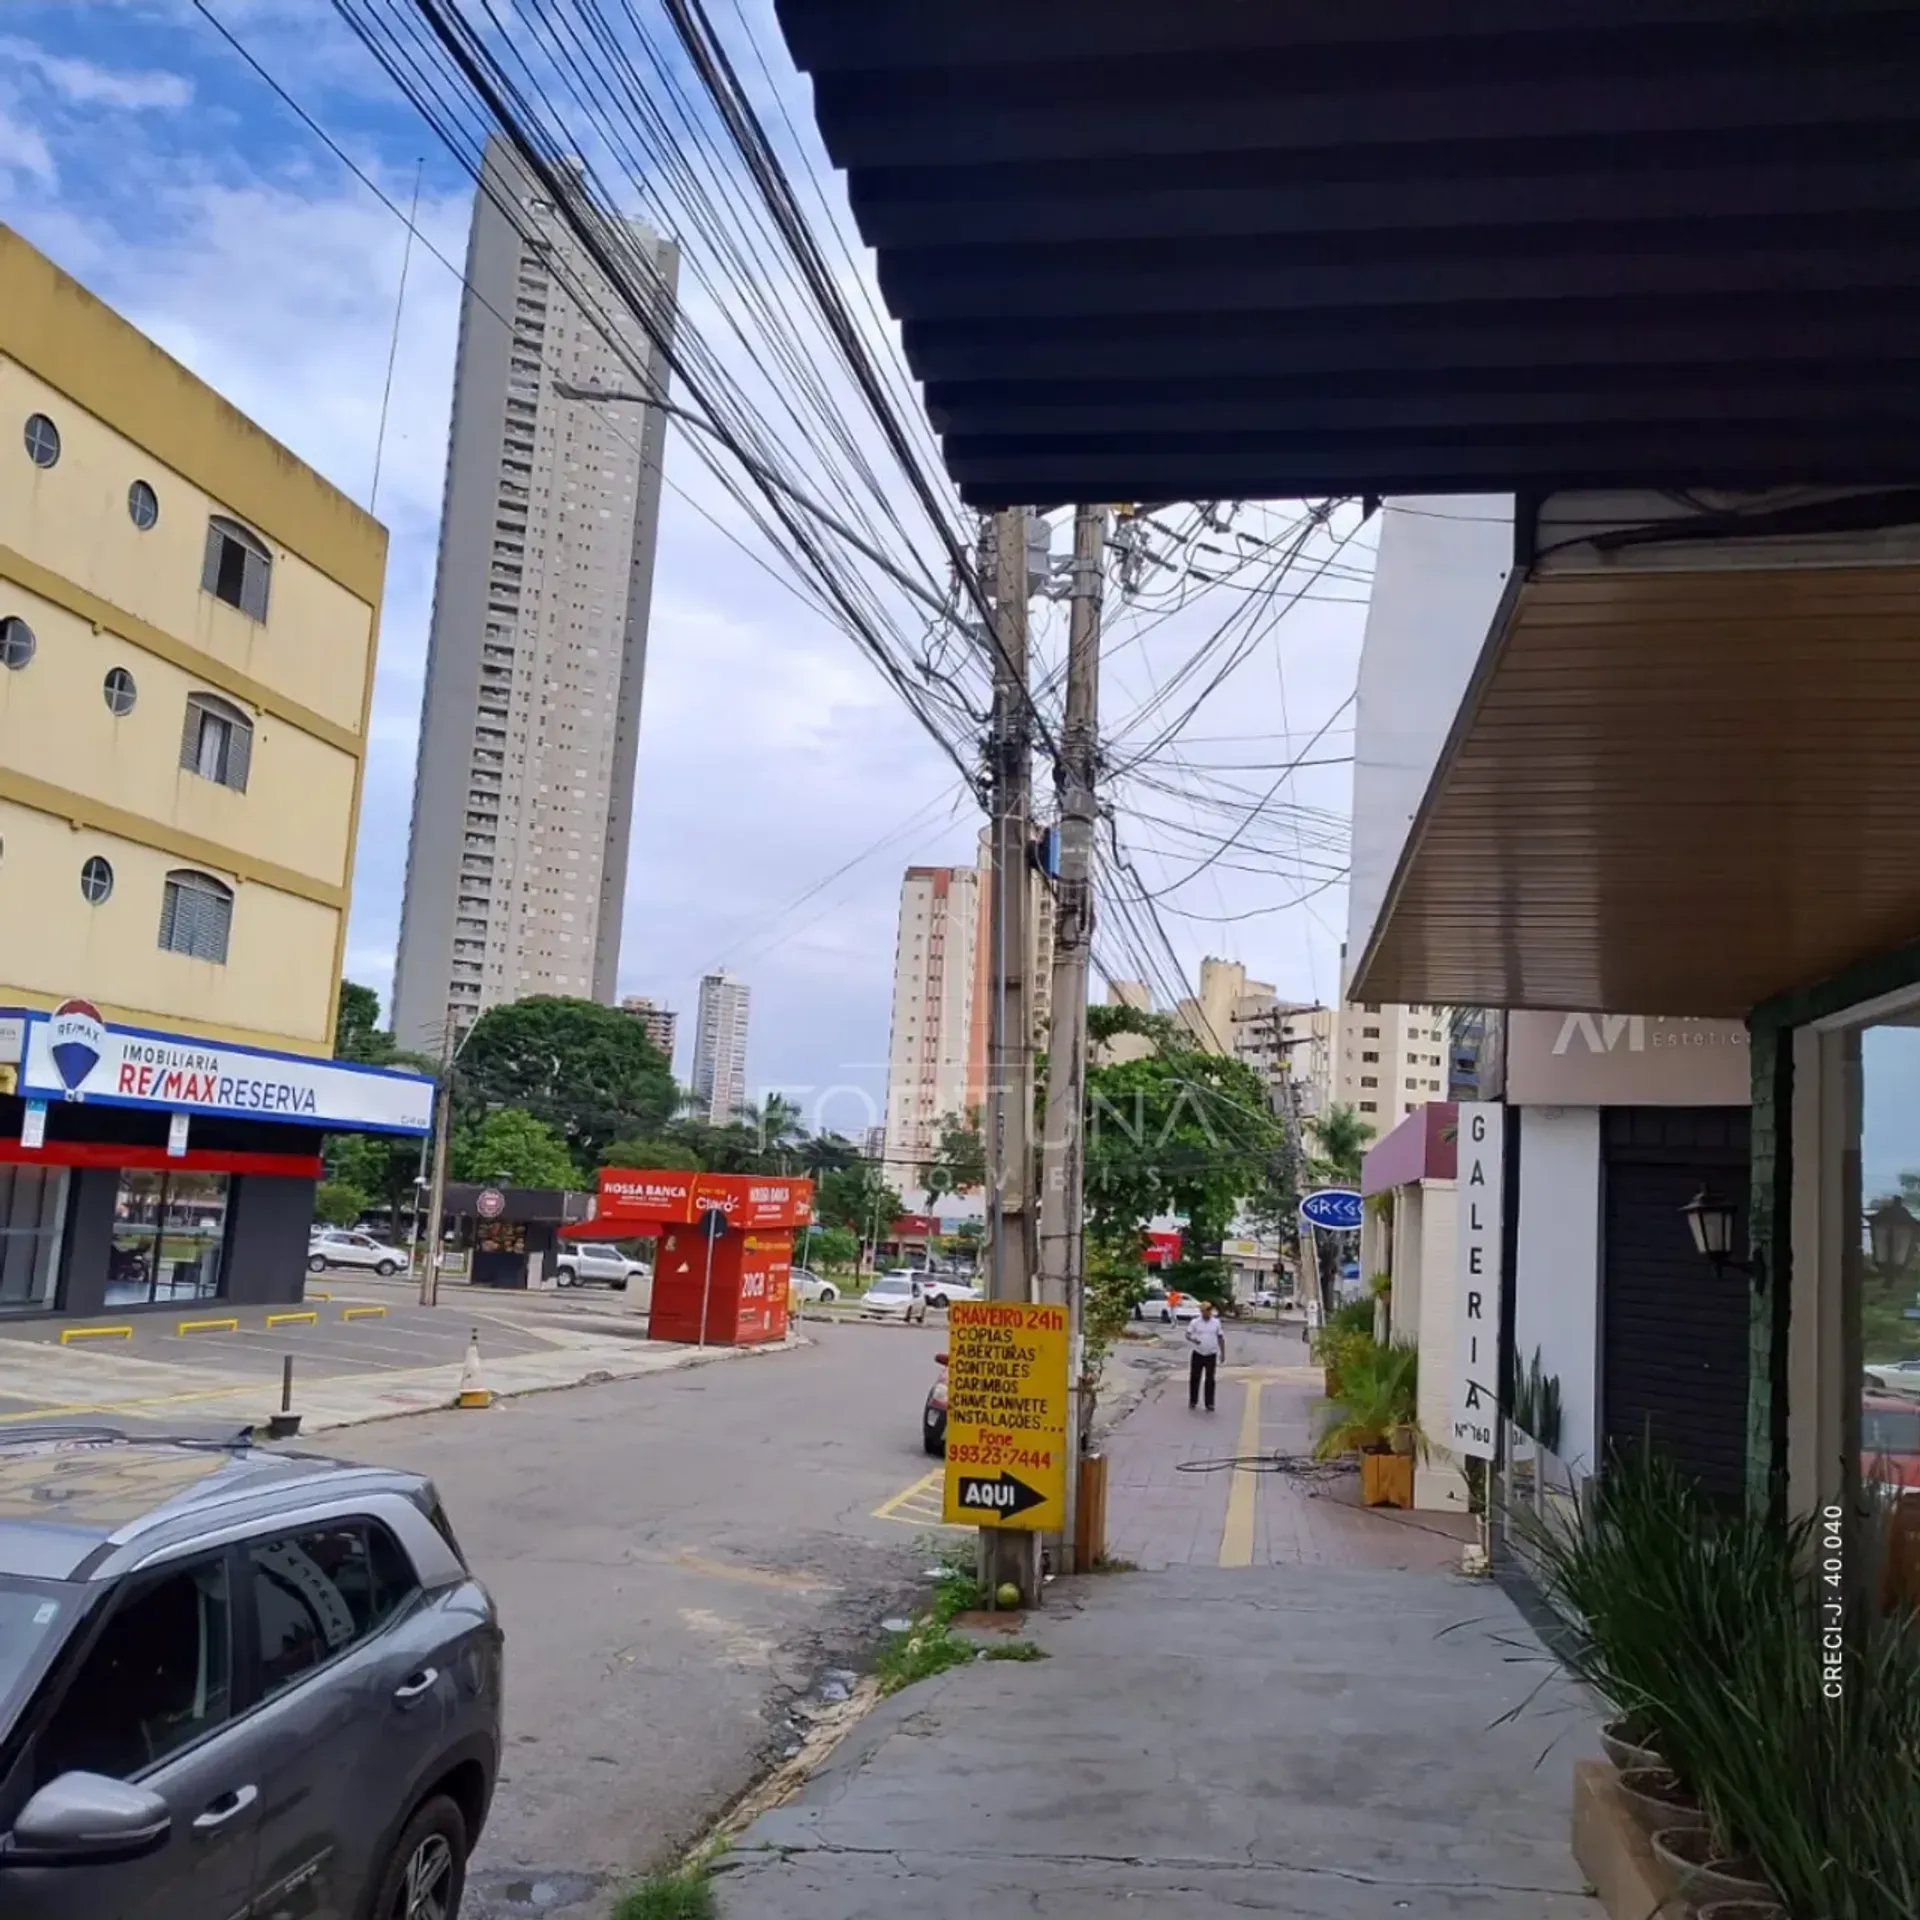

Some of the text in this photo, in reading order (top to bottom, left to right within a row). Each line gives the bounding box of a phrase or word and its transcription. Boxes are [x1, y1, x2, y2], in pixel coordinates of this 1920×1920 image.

[57, 1022, 99, 1042] RE/MAX
[118, 1062, 316, 1113] RE/MAX RESERVA
[604, 1182, 643, 1196] NOSSA
[645, 1185, 687, 1198] BANCA
[1465, 1114, 1485, 1410] GALERIA
[953, 1305, 1063, 1331] CHAVEIRO 24h
[955, 1343, 1036, 1361] ABERTURAS
[955, 1359, 1030, 1378] CONTROLES
[955, 1377, 1018, 1394] CARIMBOS
[953, 1393, 1047, 1413] CHAVE CANIVETE
[978, 1428, 1013, 1446] Fone
[964, 1482, 1016, 1507] AQUI
